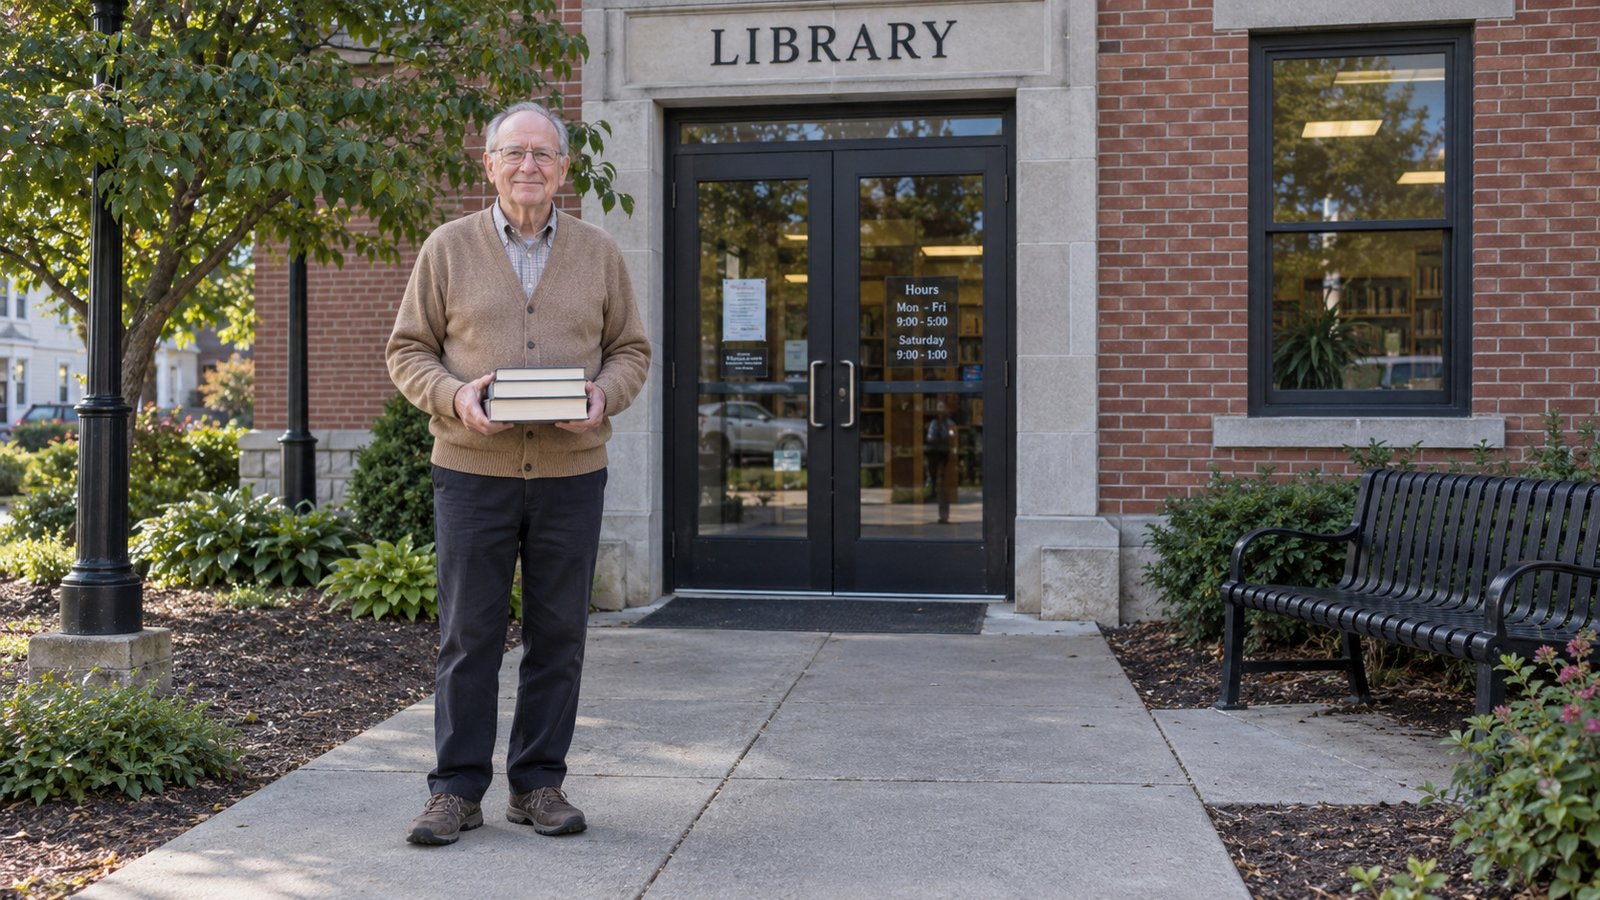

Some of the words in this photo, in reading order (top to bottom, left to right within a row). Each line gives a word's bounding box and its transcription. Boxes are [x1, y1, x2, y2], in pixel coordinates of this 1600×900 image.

[710, 20, 958, 66] LIBRARY
[905, 284, 940, 295] Hours
[896, 302, 919, 312] Mon
[932, 302, 947, 312] Fri
[896, 317, 918, 327] 9:00
[927, 317, 948, 326] 5:00
[899, 335, 945, 347] Saturday
[896, 350, 918, 360] 9:00
[927, 350, 947, 360] 1:00
